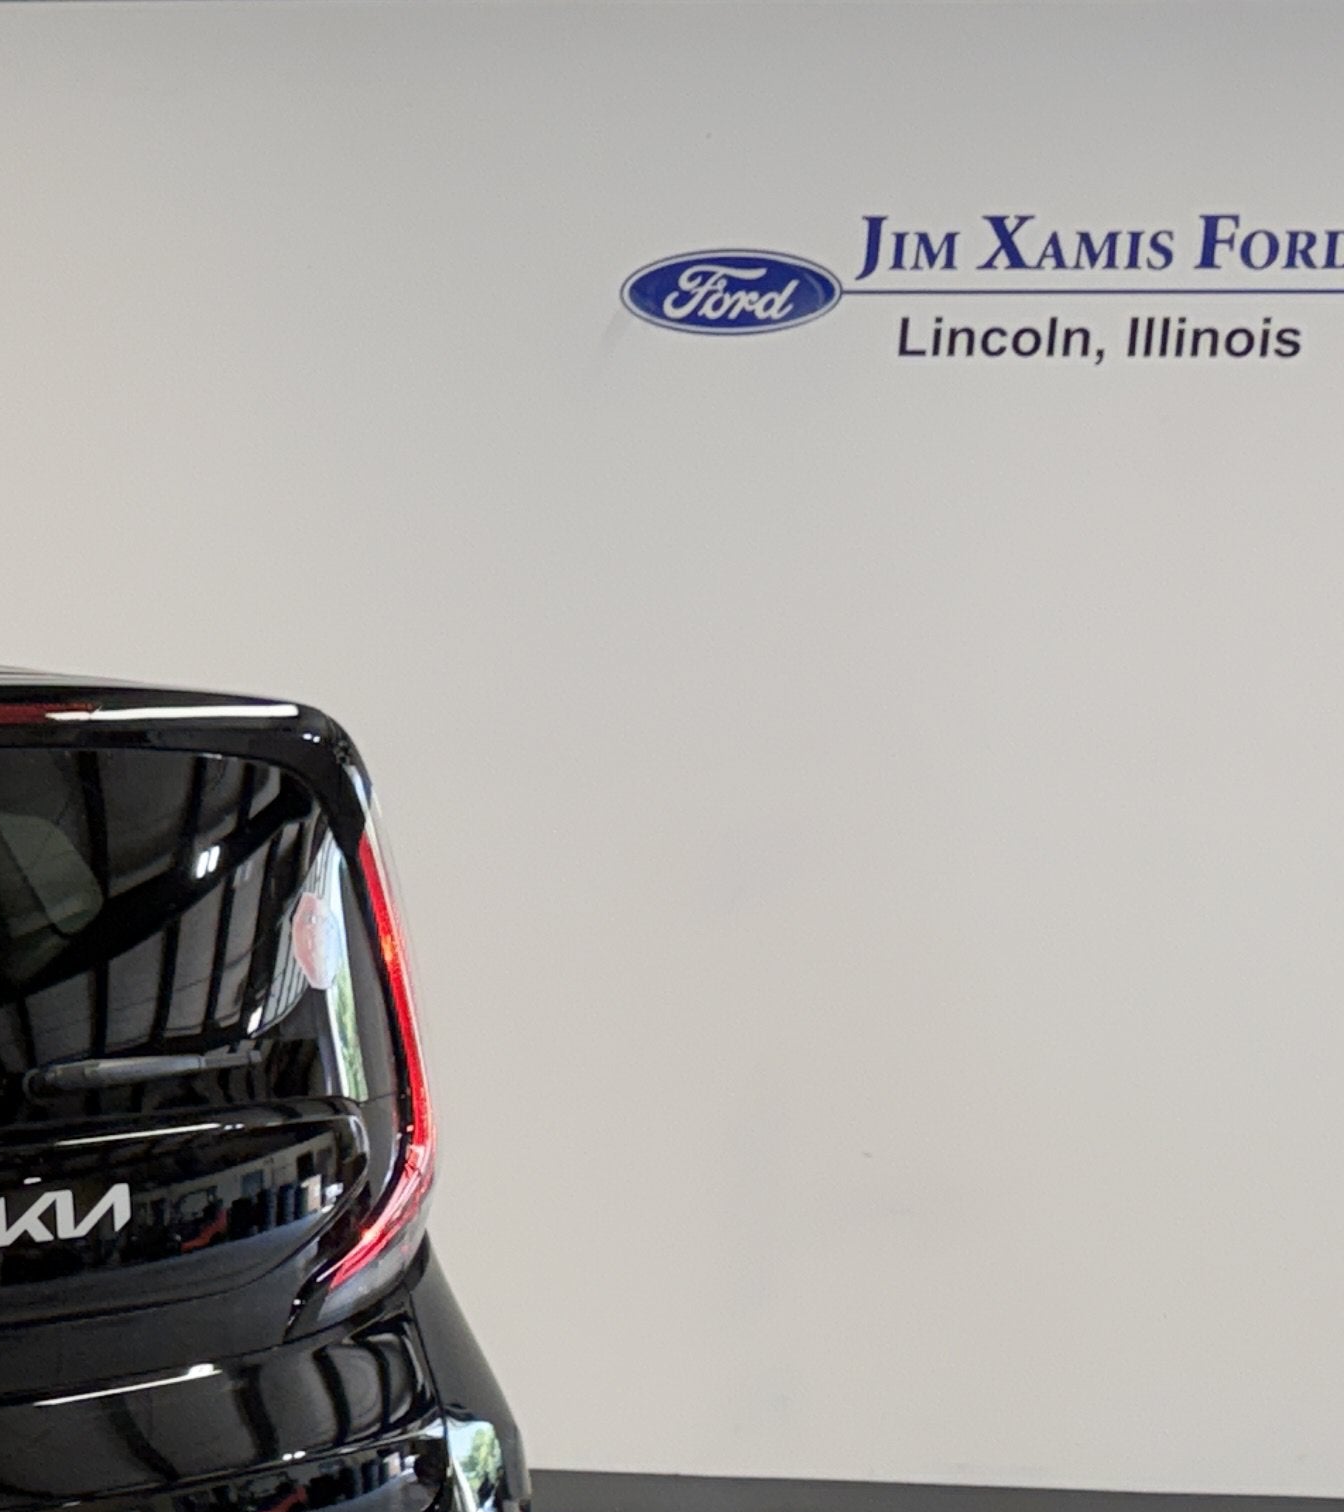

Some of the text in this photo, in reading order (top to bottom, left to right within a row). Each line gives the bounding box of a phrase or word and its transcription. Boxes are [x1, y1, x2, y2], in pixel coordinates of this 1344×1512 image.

[855, 215, 960, 280] JIM
[976, 214, 1175, 271] XAMIS
[662, 264, 800, 320] Ford
[897, 317, 1302, 364] Lincoln, Illinois
